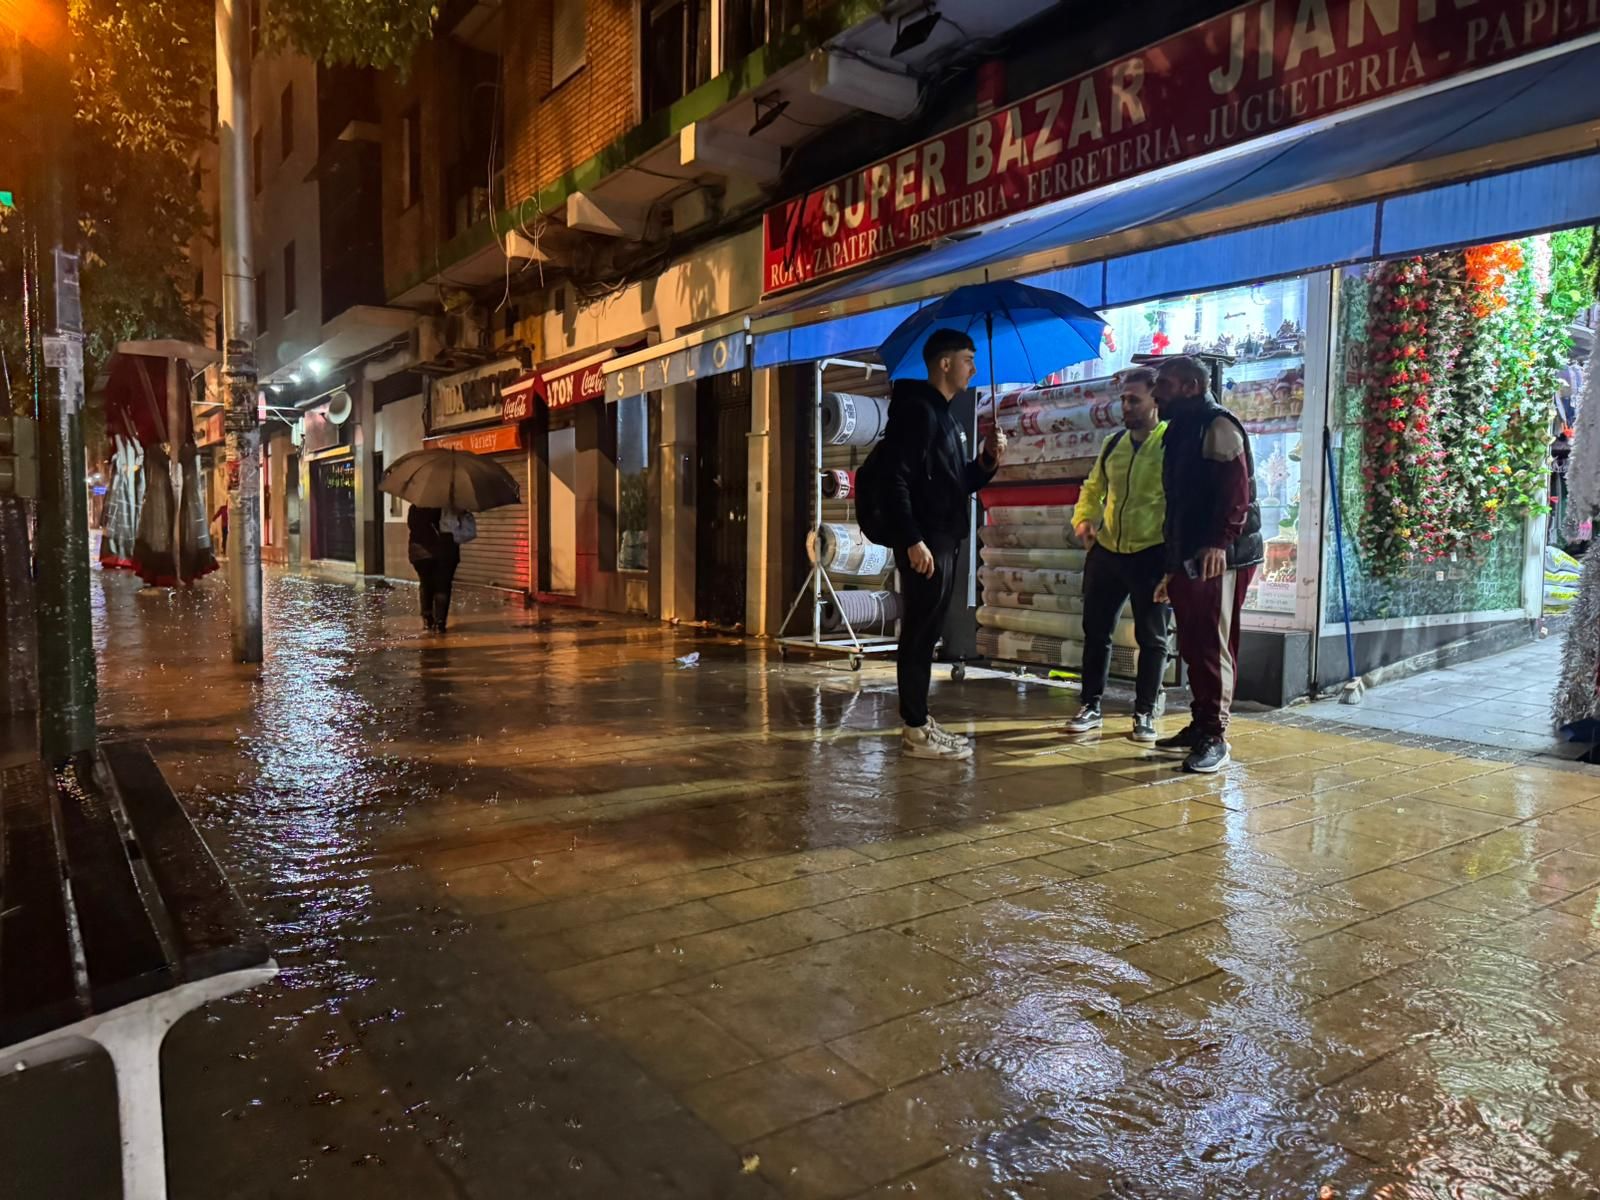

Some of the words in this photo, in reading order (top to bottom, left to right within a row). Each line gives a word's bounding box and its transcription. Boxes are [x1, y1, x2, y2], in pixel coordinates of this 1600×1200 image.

[814, 224, 896, 273] ZAPATERIA
[910, 184, 1008, 241] BISUTERIA
[1027, 125, 1181, 202] FERRETERIA
[1204, 41, 1426, 145] JUGUETERIA
[822, 140, 946, 237] SUPER
[966, 57, 1147, 185] BAZAR
[1208, 0, 1481, 95] JIAN
